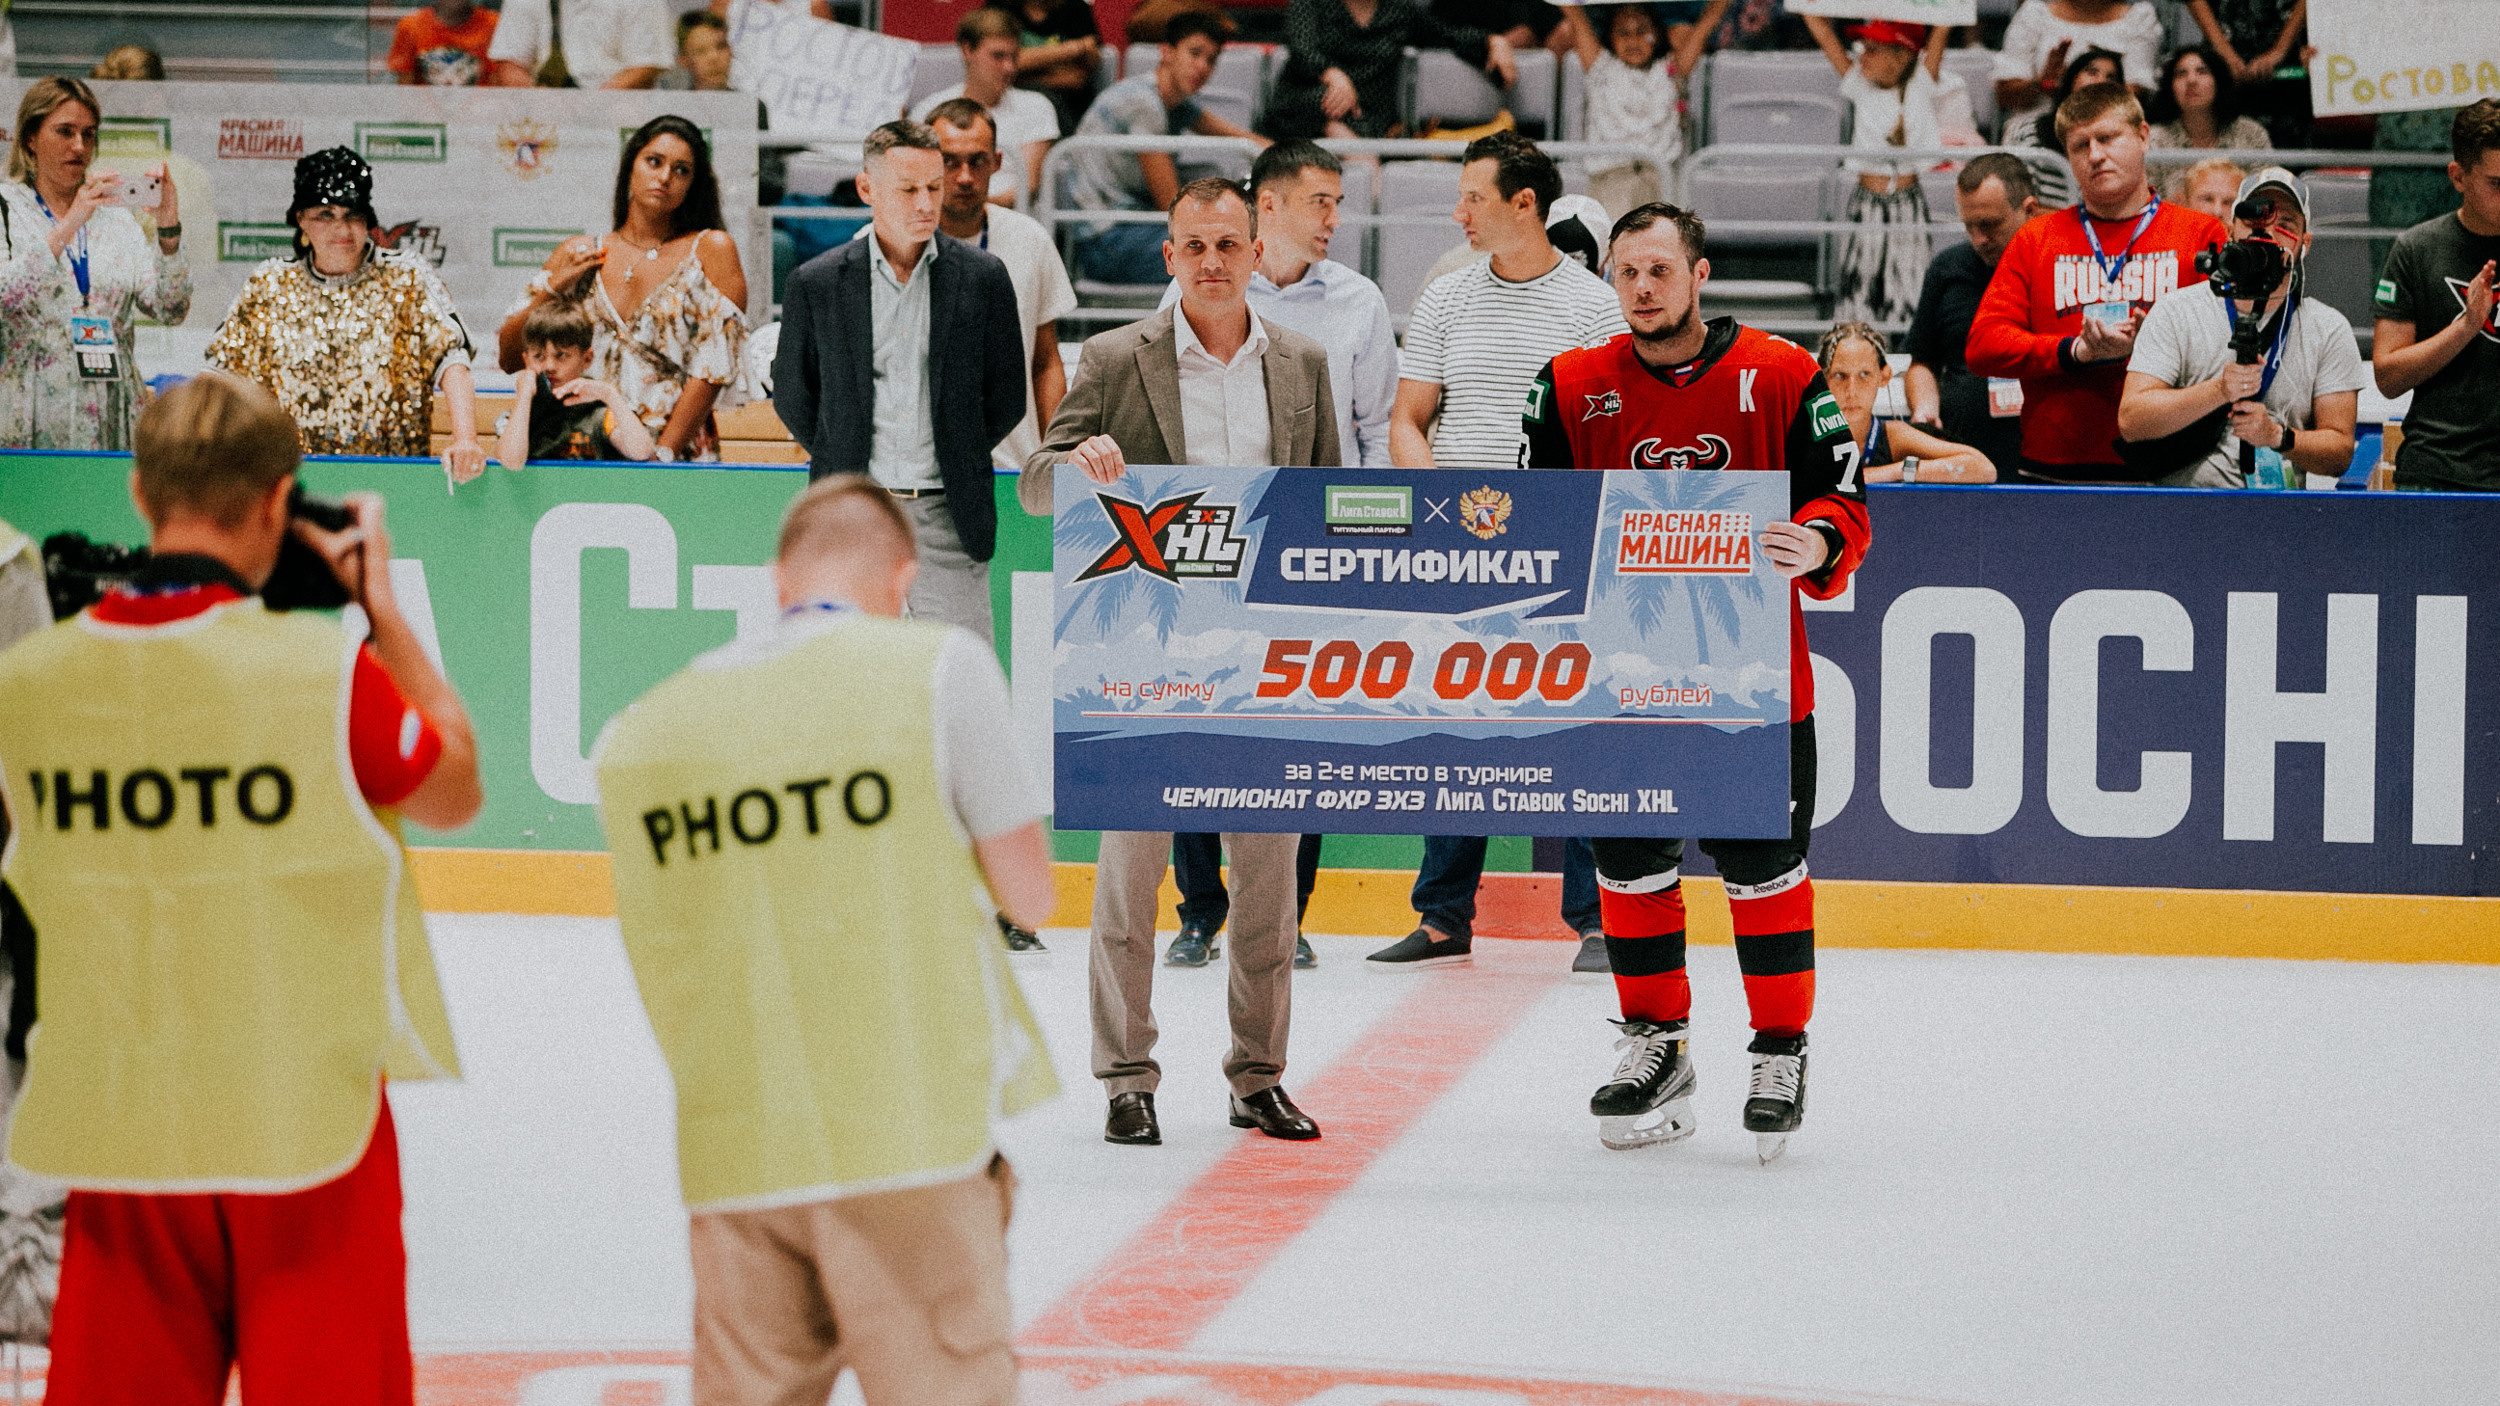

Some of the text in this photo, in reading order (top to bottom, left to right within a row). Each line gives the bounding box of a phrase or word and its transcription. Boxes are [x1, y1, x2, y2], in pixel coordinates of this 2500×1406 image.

[218, 134, 303, 153] МАШИНА
[2054, 256, 2179, 311] RUSSIA
[1832, 440, 1860, 493] 7
[1093, 499, 1241, 575] XHL
[1623, 513, 1722, 534] КРАСНАЯ
[1619, 534, 1751, 565] МАШИНА
[1280, 547, 1560, 584] СЕРТИФИКАТ
[1255, 639, 1593, 702] 500 000
[1102, 681, 1216, 701] на сумму
[1619, 683, 1713, 707] рублей
[1284, 761, 1553, 786] за 2-е место в турнире
[1162, 786, 1312, 810] ЧЕМПИОНАТ
[1315, 789, 1372, 810] ФХР
[1636, 788, 1679, 814] XHL
[642, 769, 893, 866] PHOTO
[1753, 877, 1792, 895] Reebok
